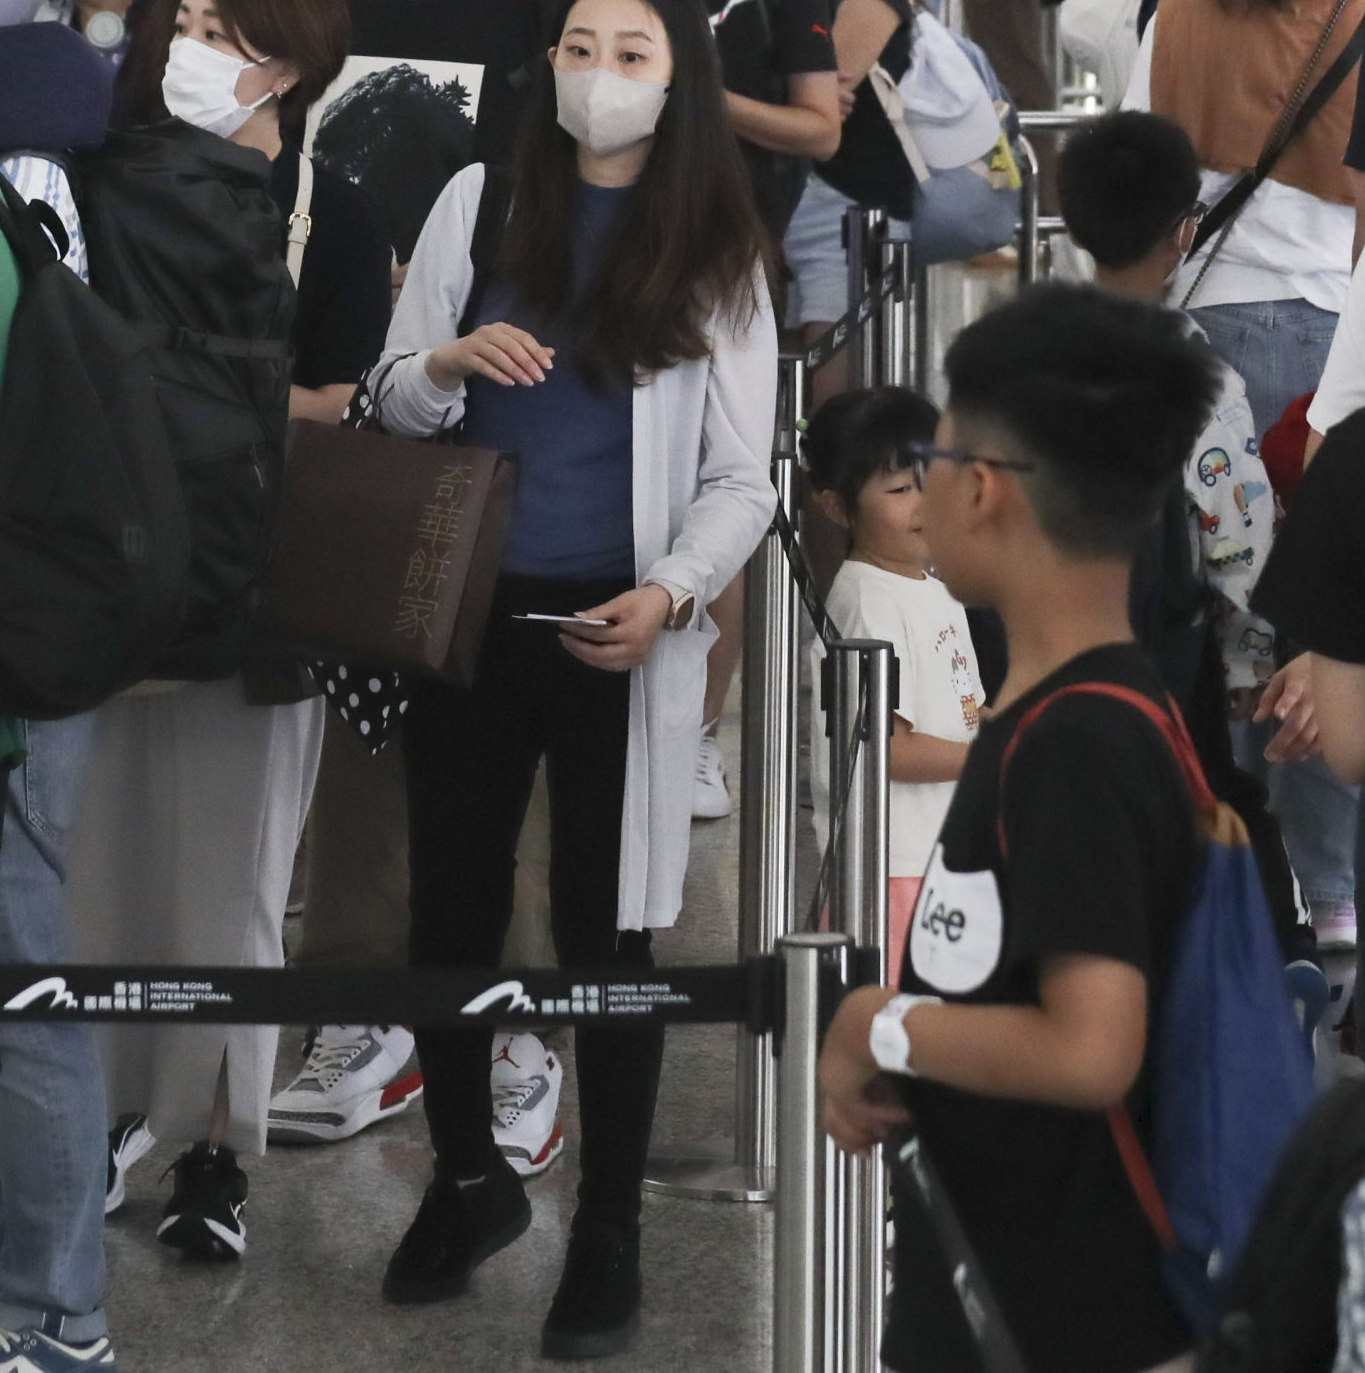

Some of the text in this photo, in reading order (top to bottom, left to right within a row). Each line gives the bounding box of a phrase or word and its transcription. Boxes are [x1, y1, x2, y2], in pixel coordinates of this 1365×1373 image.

[392, 463, 472, 639] 奇華餅家
[922, 887, 965, 942] Lee
[150, 982, 212, 990] HONG KONG
[608, 984, 670, 992] HONG KONG
[150, 992, 233, 1001] INTERNATIONAL
[608, 994, 691, 1003] INTERNATIONAL
[150, 1003, 195, 1011] AIRPORT
[608, 1004, 653, 1013] AIRPORT
